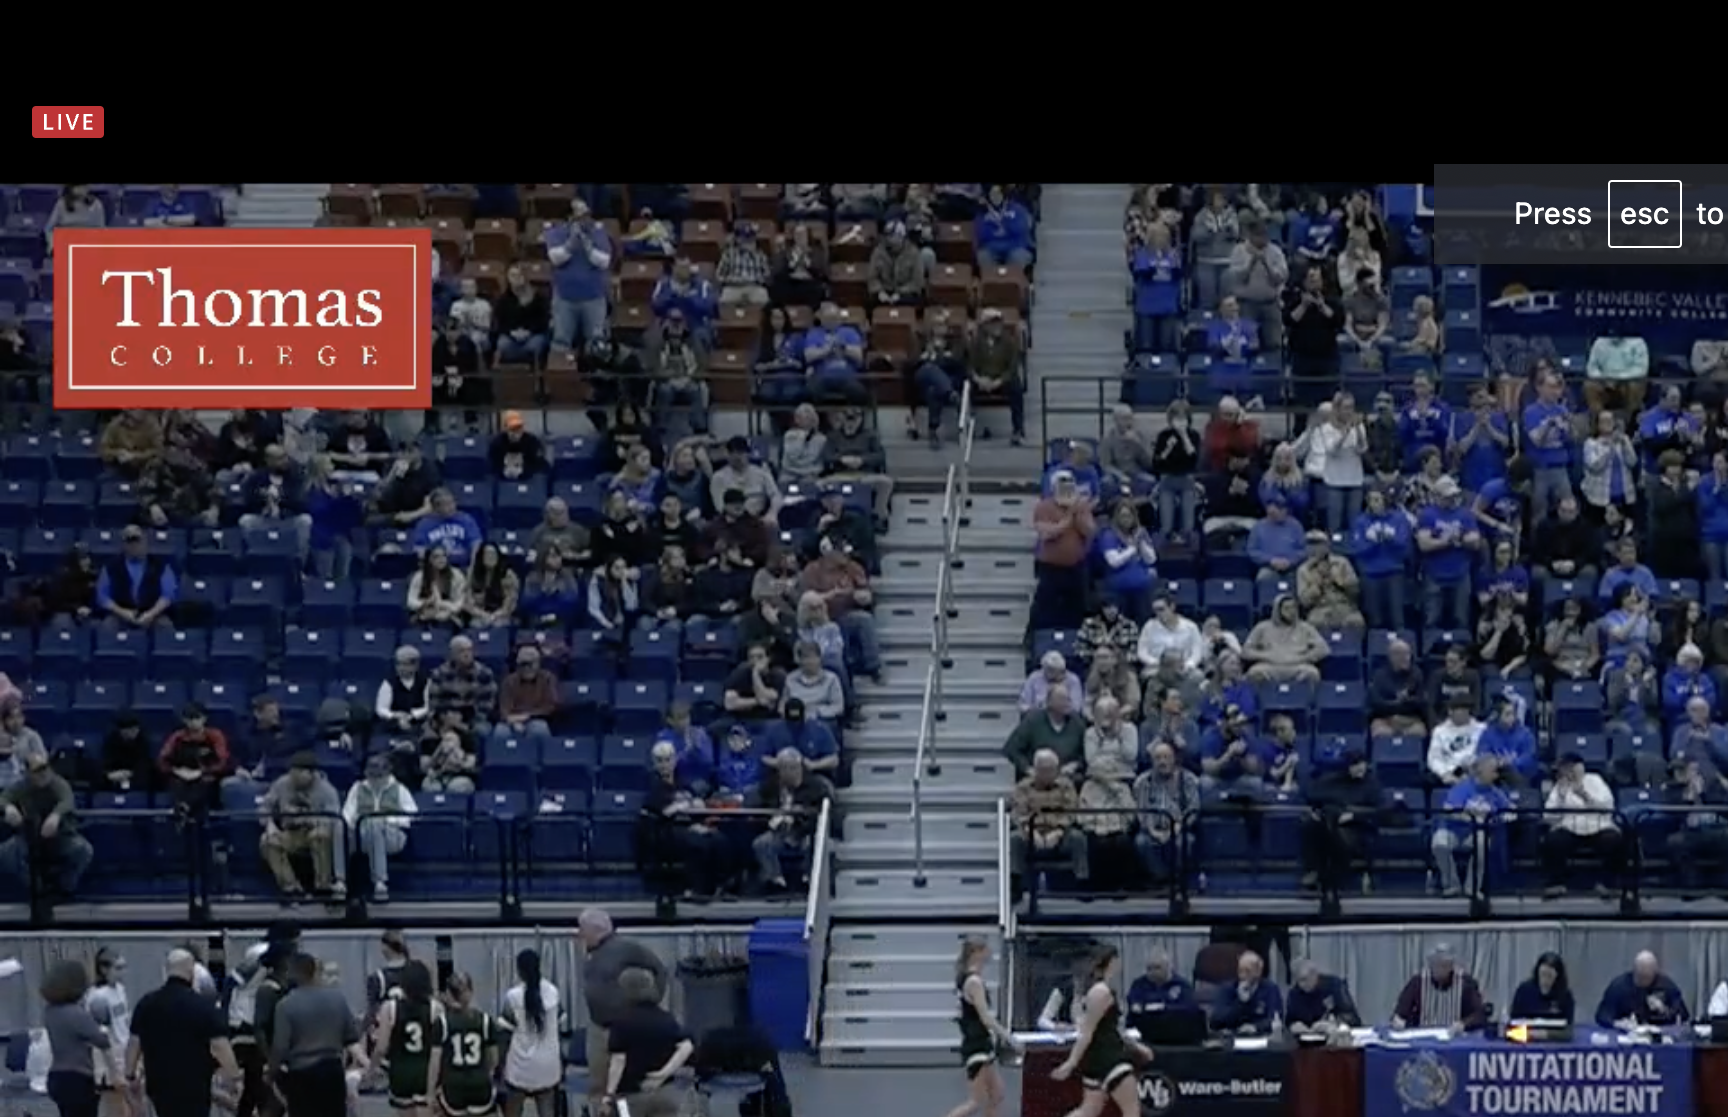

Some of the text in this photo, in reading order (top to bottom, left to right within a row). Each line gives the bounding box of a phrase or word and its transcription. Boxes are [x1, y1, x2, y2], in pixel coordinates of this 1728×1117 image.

[404, 1021, 424, 1053] 3
[451, 1033, 482, 1066] 13
[1468, 1052, 1662, 1080] INVITATIONAL
[1178, 1078, 1282, 1096] Ware-Butler
[1466, 1085, 1664, 1113] TOURNAMENT
